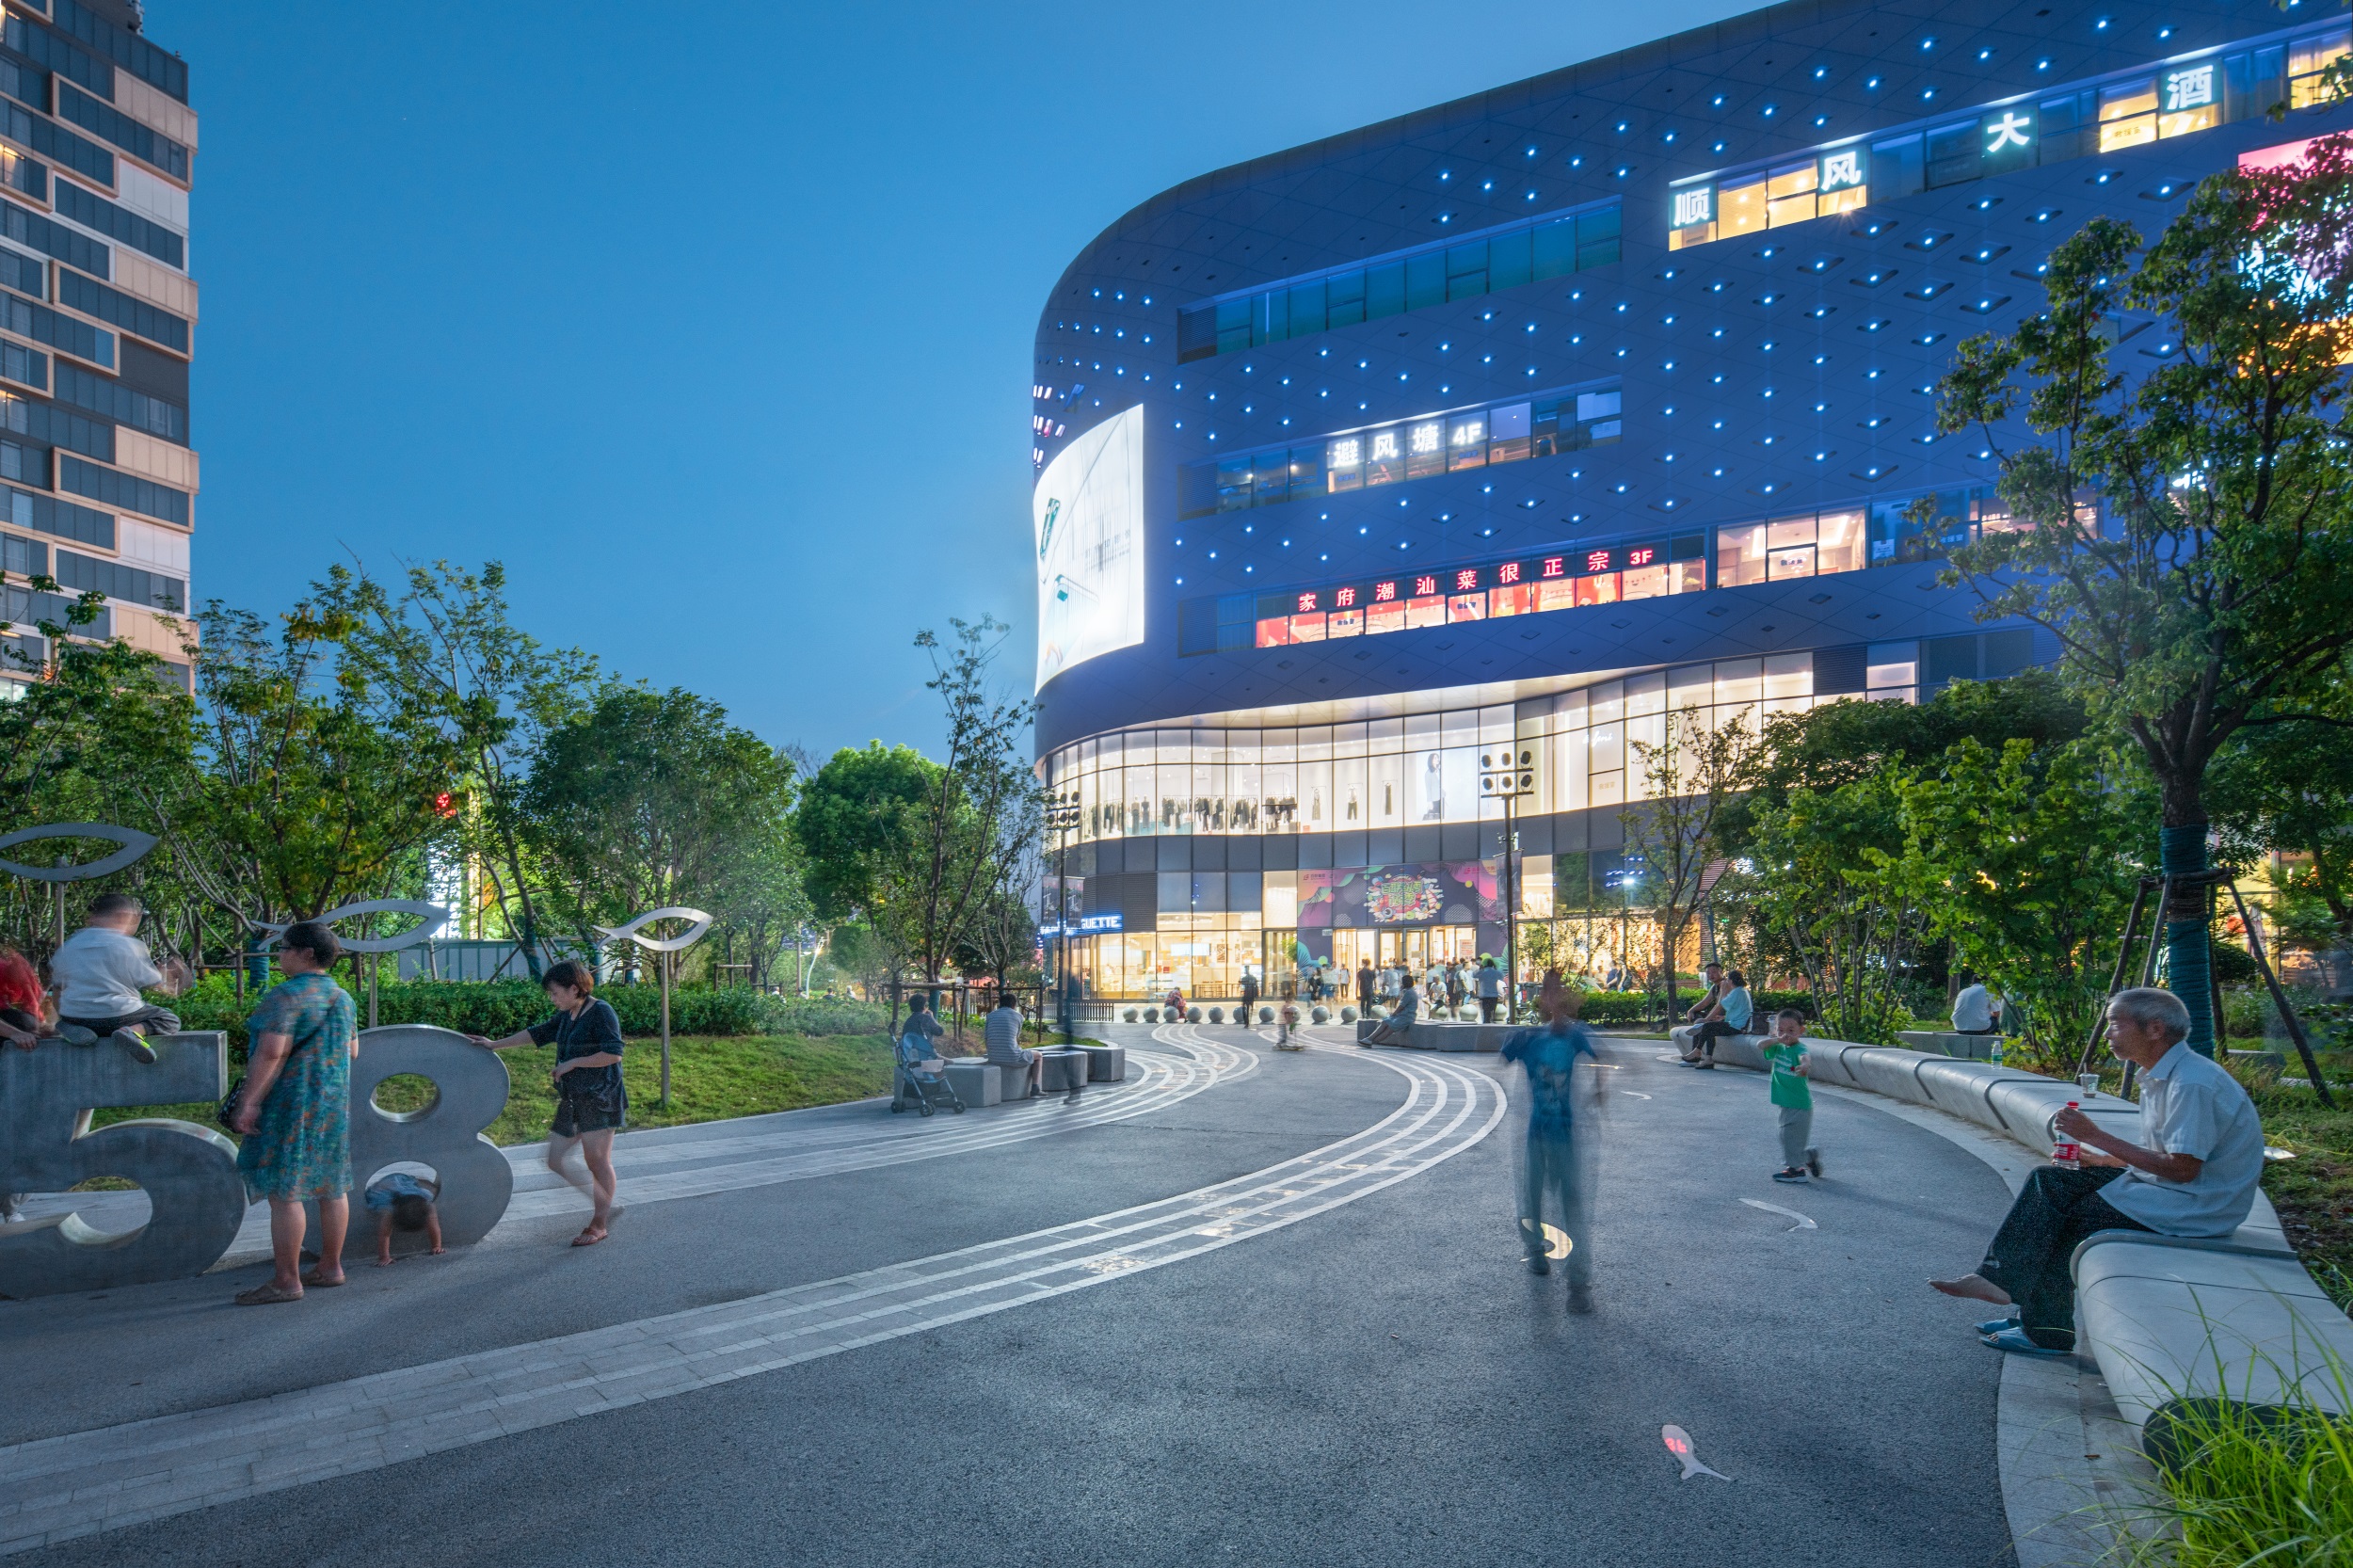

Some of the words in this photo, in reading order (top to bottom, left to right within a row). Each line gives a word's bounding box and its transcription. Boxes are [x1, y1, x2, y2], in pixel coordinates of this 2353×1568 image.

[1673, 64, 2214, 227] 顺风大酒
[1334, 424, 1440, 467] 避风塘
[1452, 422, 1482, 445] 4F
[1299, 551, 1609, 613] 家府潮汕菜很正宗
[1629, 549, 1653, 565] 3F
